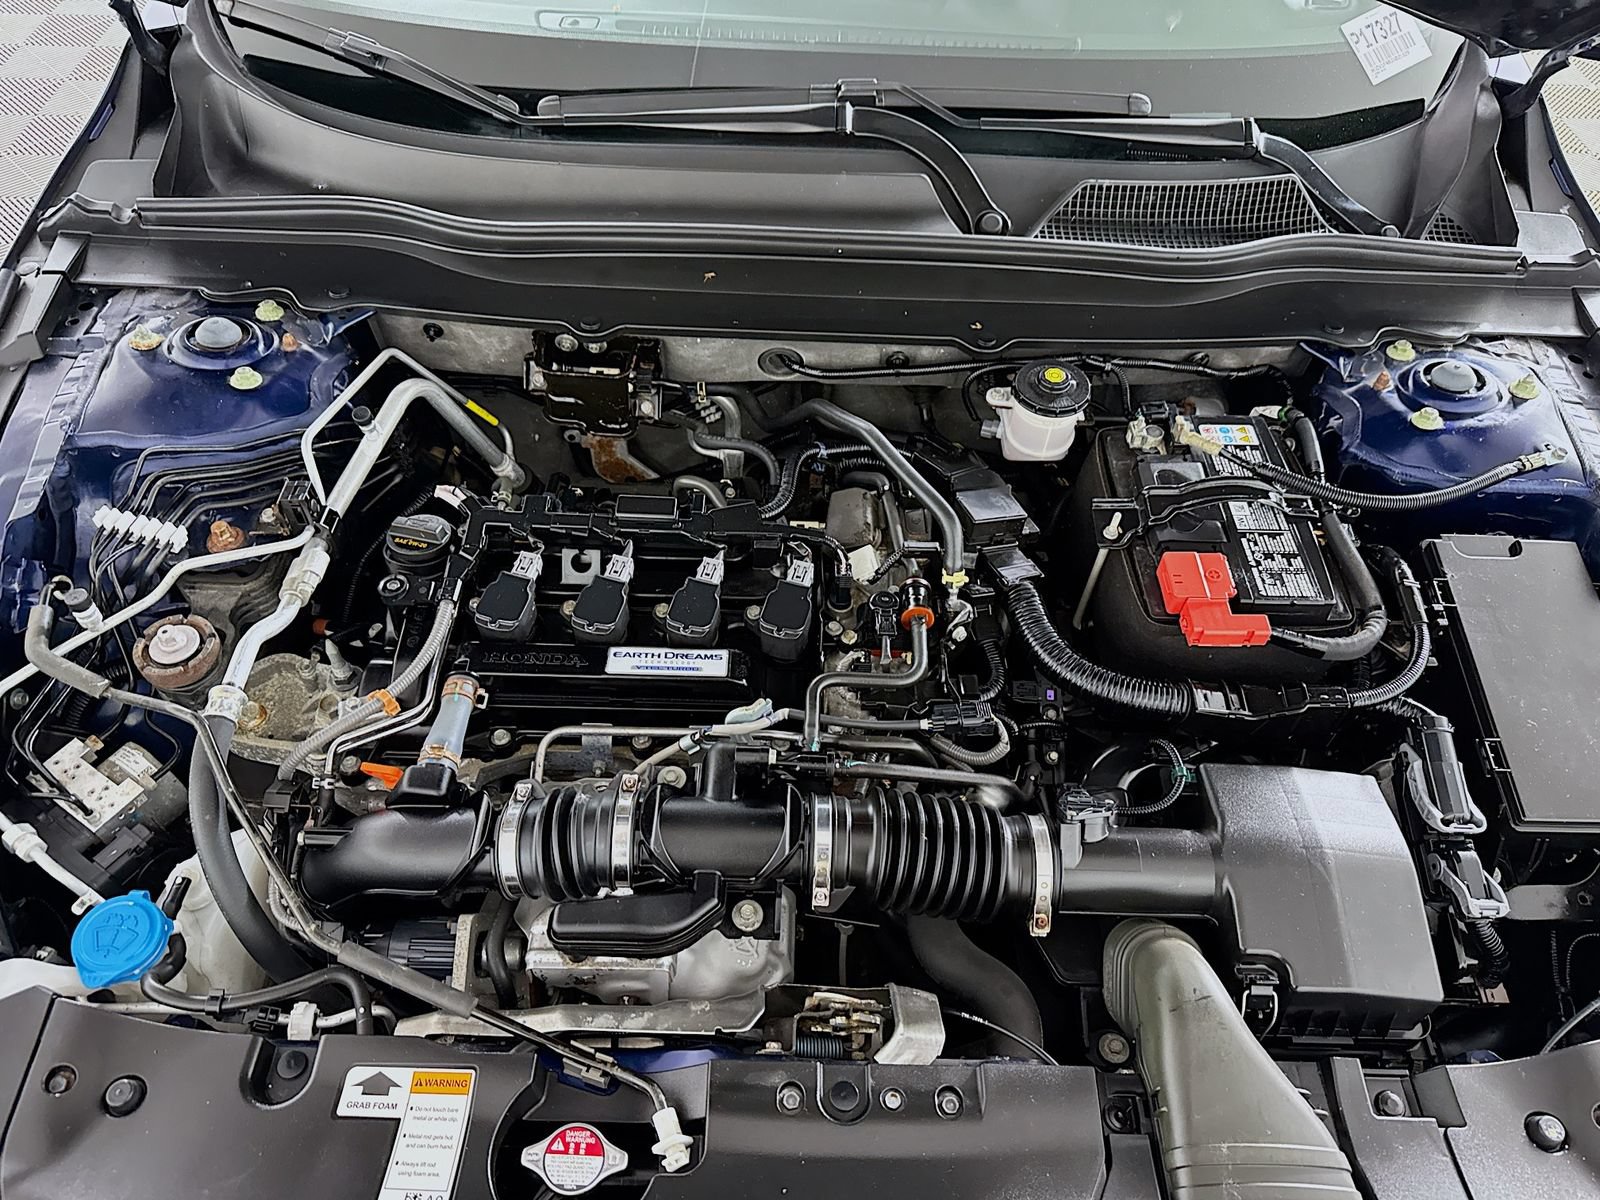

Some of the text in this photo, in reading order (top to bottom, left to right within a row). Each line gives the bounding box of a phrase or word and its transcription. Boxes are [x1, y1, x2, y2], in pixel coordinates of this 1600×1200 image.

[482, 652, 589, 667] HONDA
[612, 651, 661, 659] EARTH
[424, 1078, 468, 1088] WARNING
[346, 1101, 398, 1110] GRAB FOAM
[565, 1130, 591, 1138] DANGER
